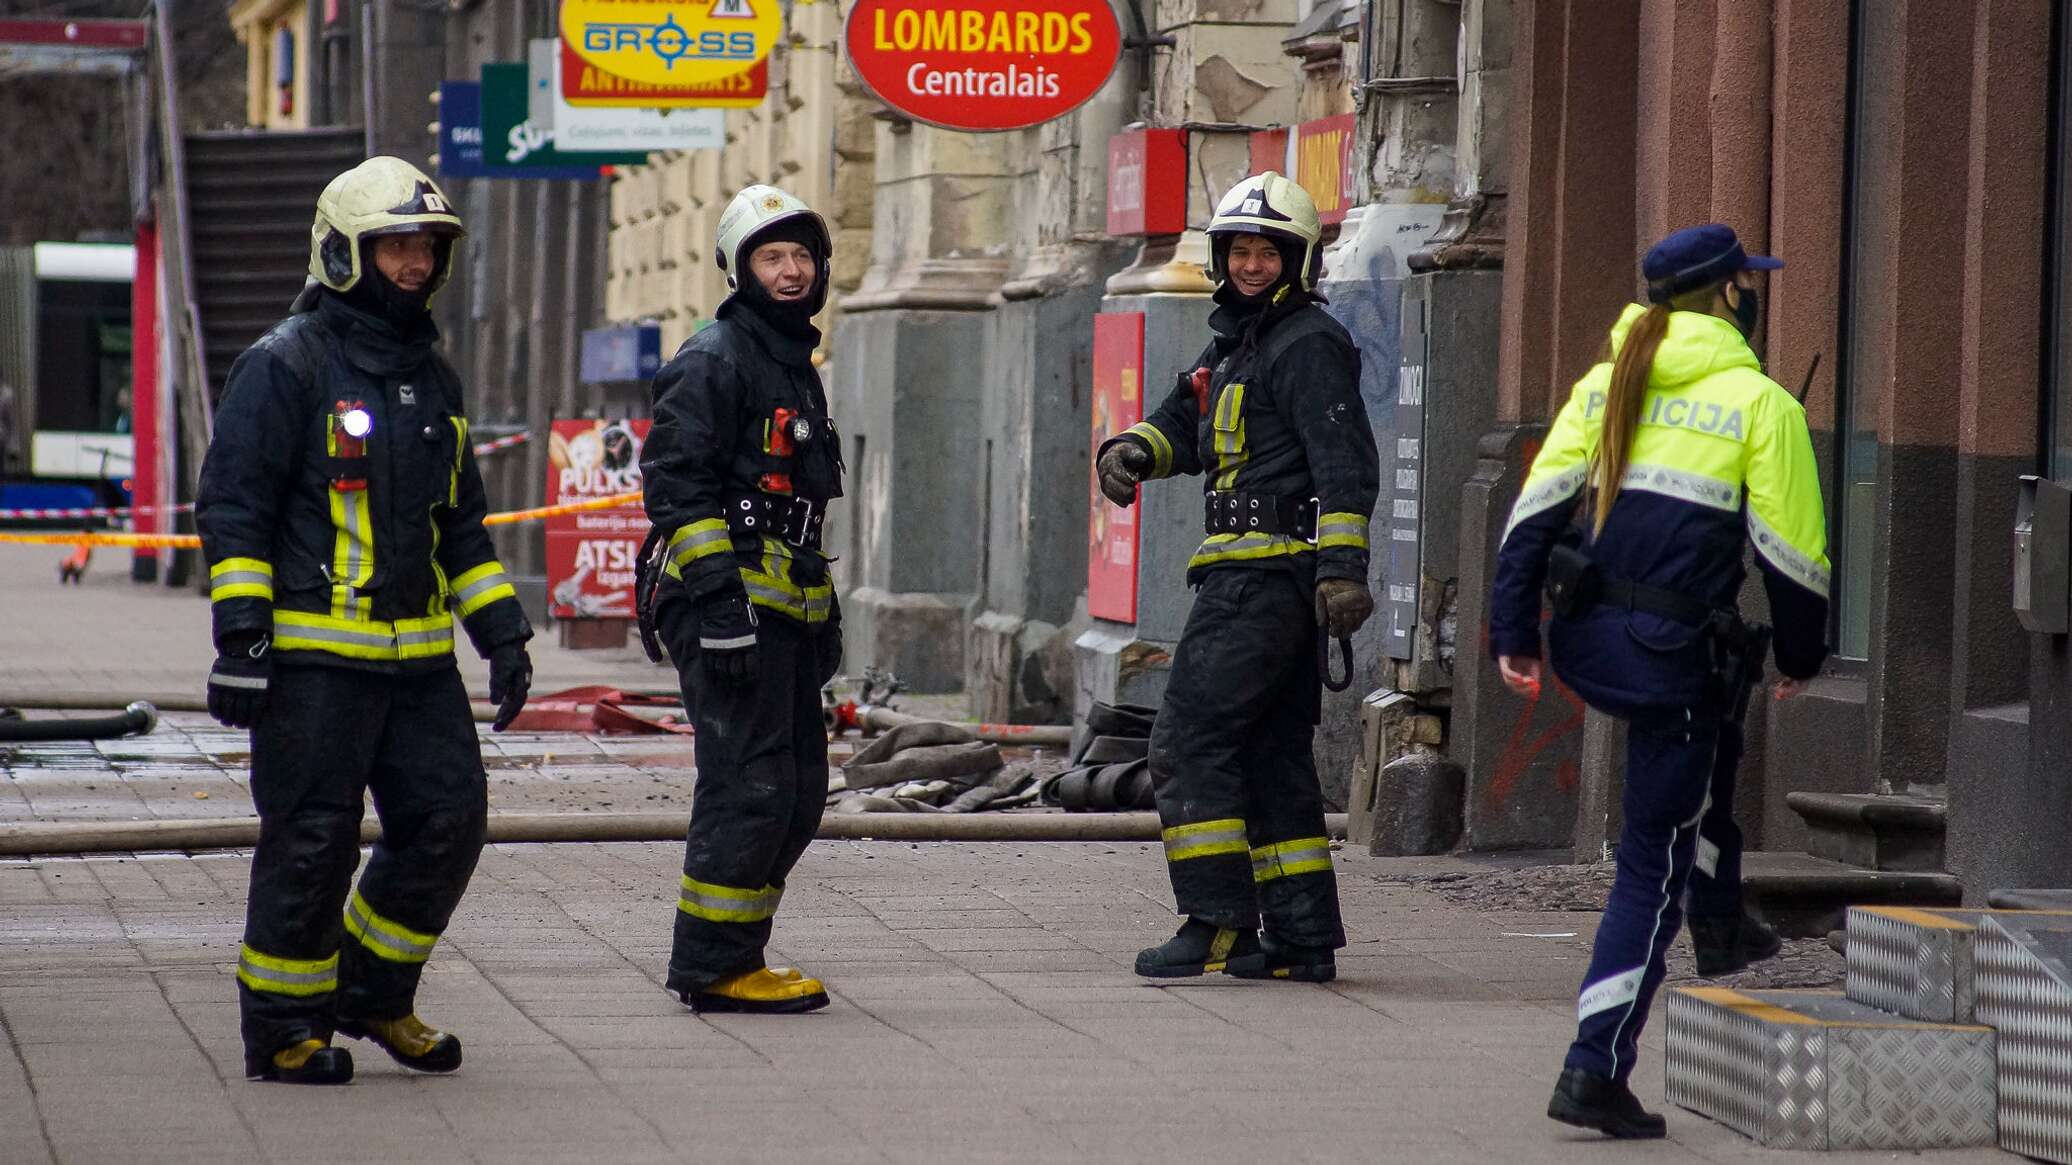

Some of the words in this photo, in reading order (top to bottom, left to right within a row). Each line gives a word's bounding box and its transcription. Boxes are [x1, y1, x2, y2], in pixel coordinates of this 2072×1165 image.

[584, 24, 756, 60] GROSS
[874, 8, 1093, 54] LOMBARDS
[907, 62, 1060, 97] Centralais
[1585, 391, 1743, 440] PICIJA
